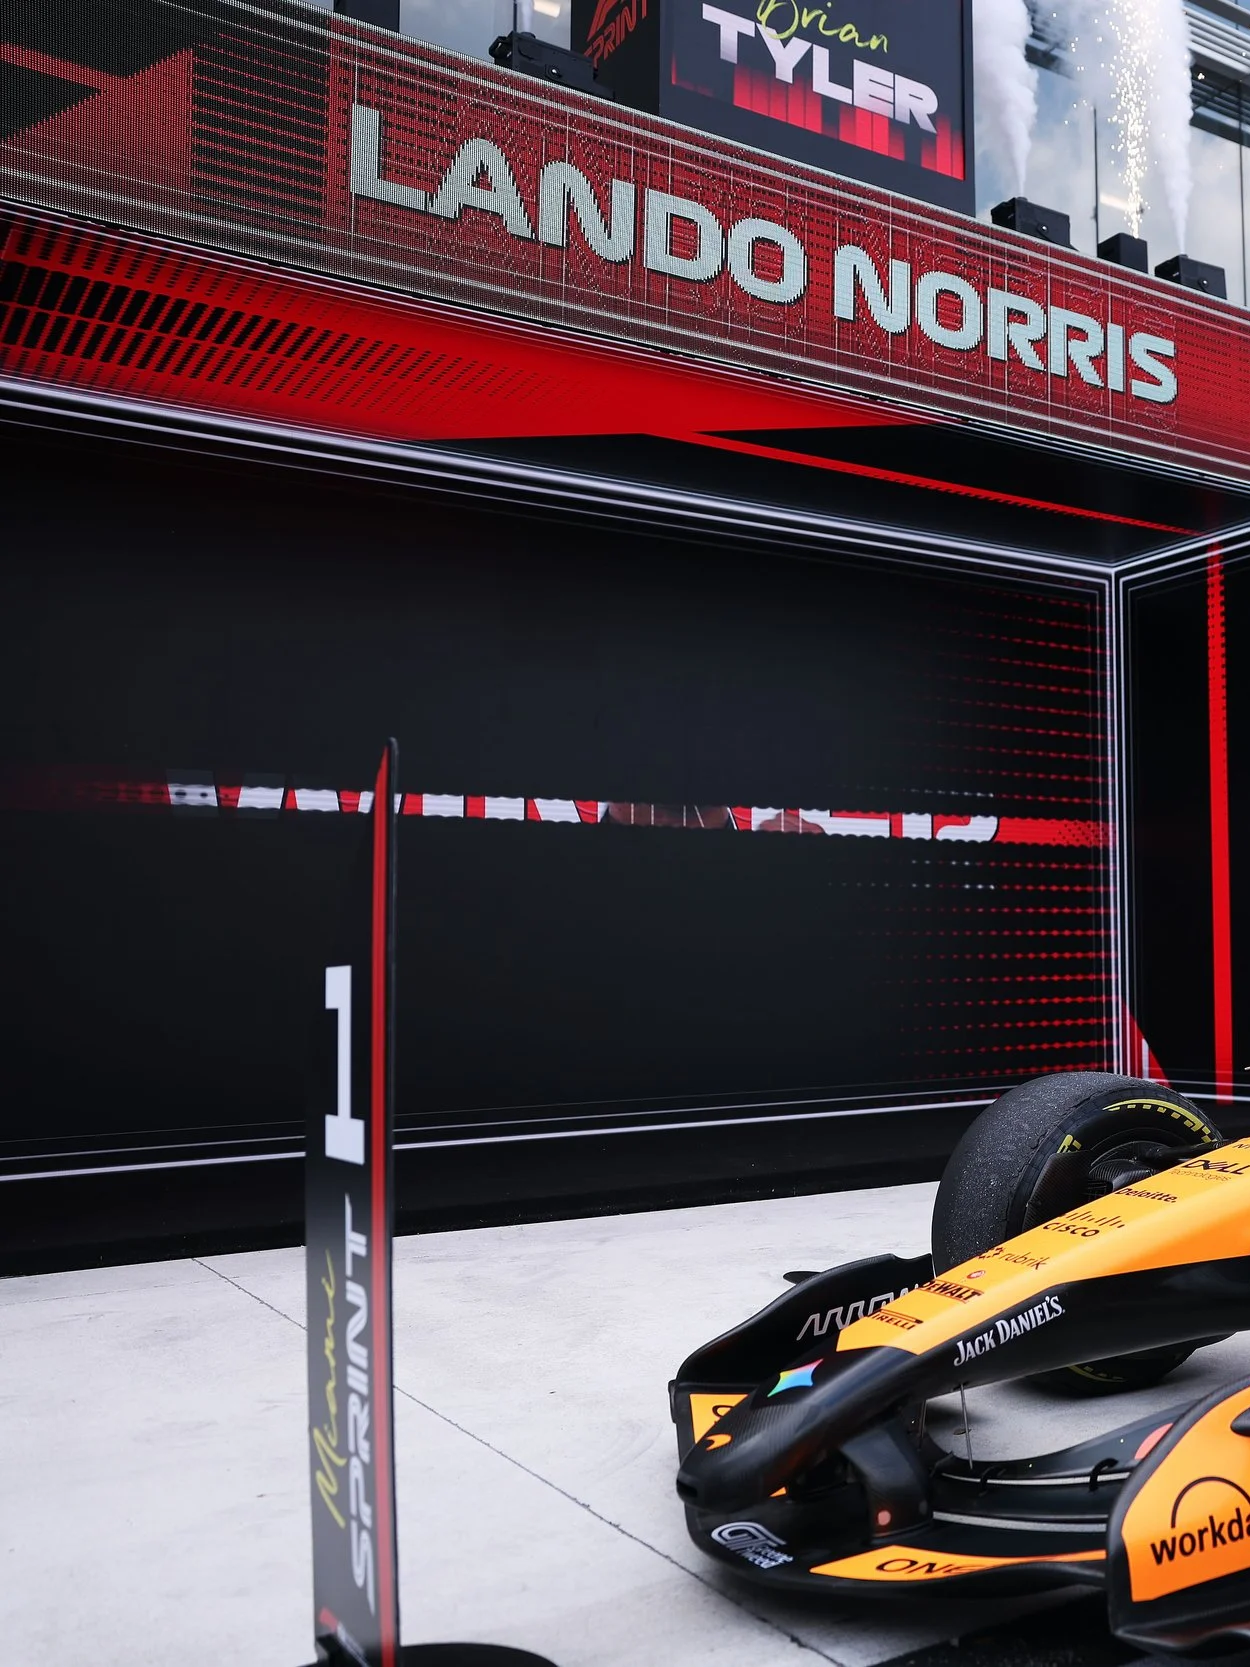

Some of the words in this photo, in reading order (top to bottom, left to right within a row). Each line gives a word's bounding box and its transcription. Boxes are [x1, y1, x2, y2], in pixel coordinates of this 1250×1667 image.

[702, 4, 939, 135] TYLER
[350, 103, 807, 305] LANDO
[833, 243, 1180, 404] NORRIS
[326, 965, 365, 1164] 1
[954, 1329, 996, 1367] JACK
[1000, 1250, 1051, 1270] rubrik
[314, 1249, 347, 1529] Miami
[345, 1193, 376, 1616] SPRINT
